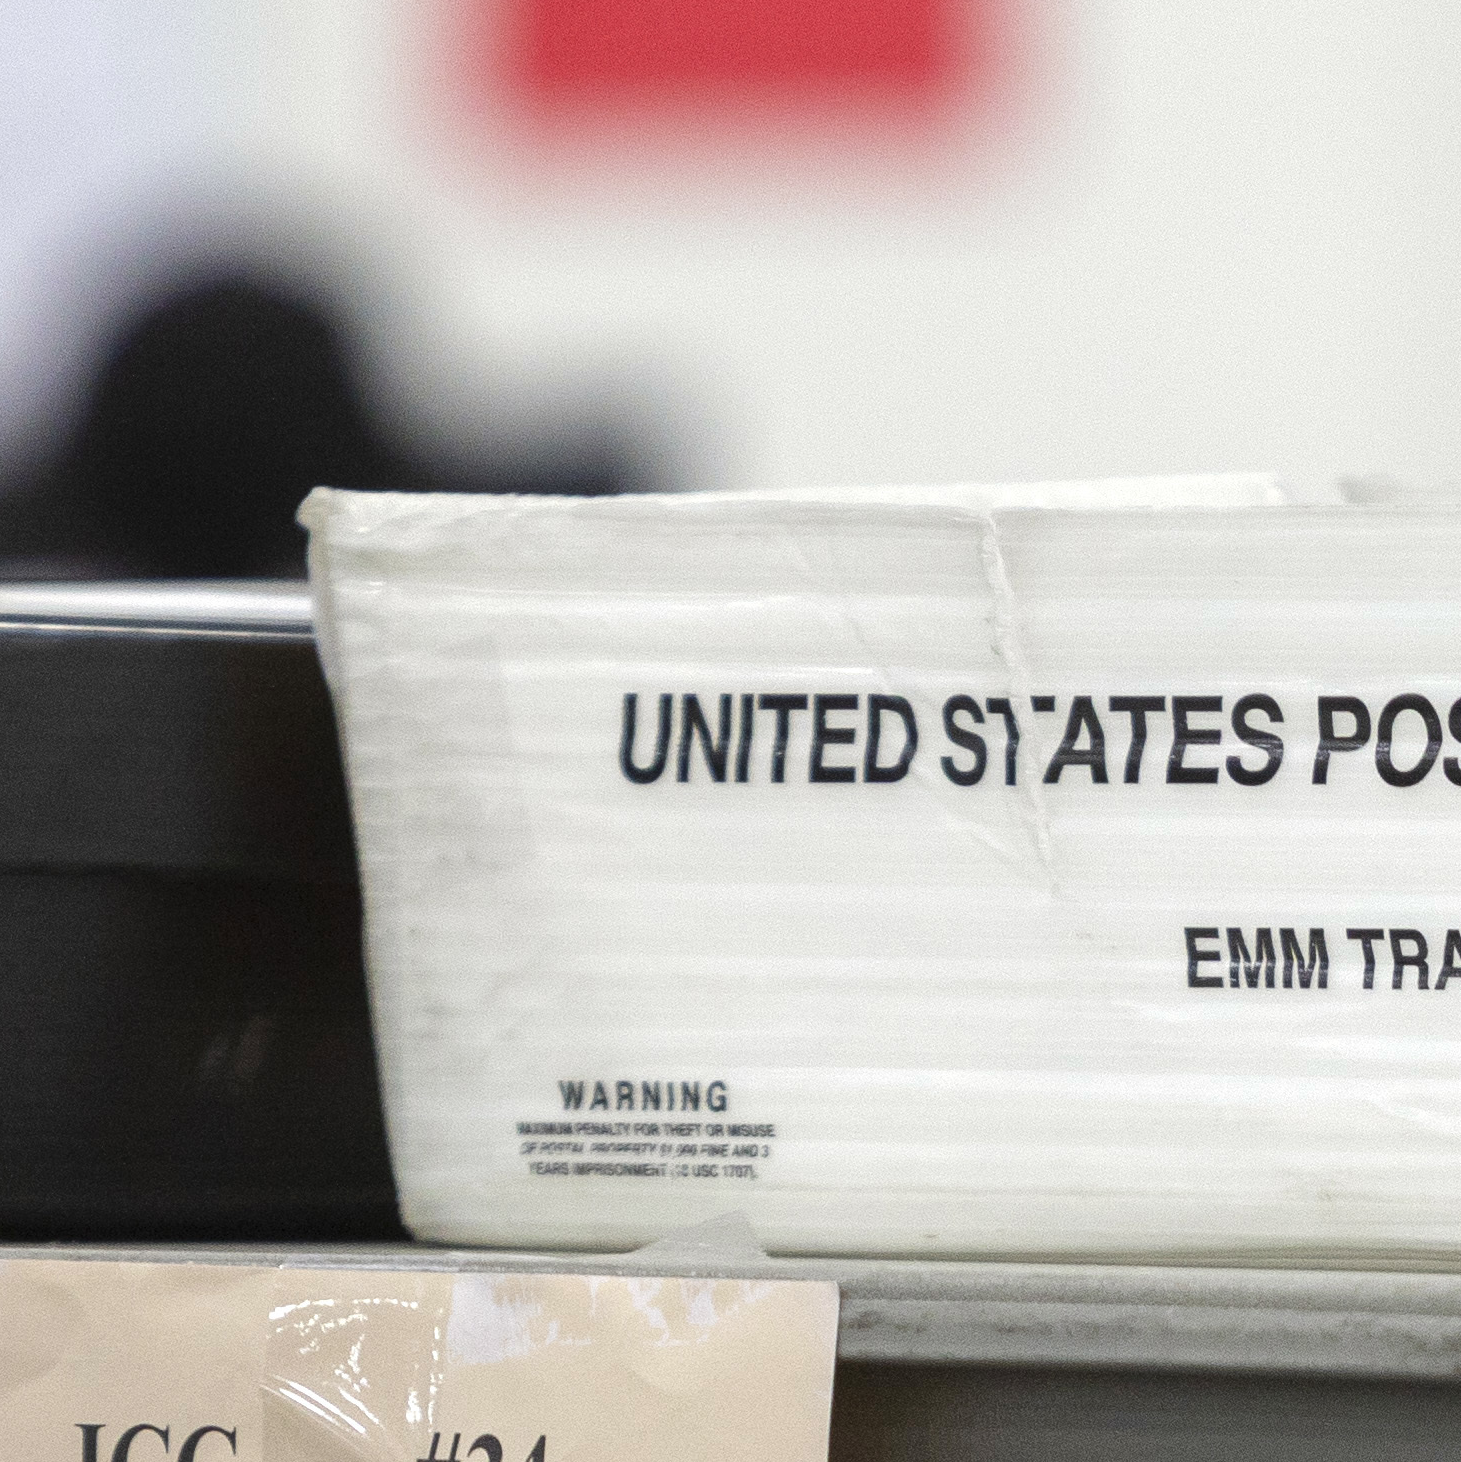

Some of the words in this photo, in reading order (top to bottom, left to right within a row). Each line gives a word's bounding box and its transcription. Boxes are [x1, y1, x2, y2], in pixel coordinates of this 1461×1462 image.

[619, 693, 920, 786] UNITED
[940, 692, 1285, 788] STATES
[1183, 926, 1330, 990] EMM
[558, 1079, 729, 1112] WARNING
[574, 1122, 630, 1136] PENALTY
[633, 1123, 659, 1136] FOR
[663, 1123, 701, 1137] THEFT
[705, 1123, 724, 1137] OR
[727, 1123, 776, 1138] MISUSE
[731, 1144, 759, 1158] AND
[761, 1144, 770, 1158] 3
[692, 1164, 719, 1178] USC
